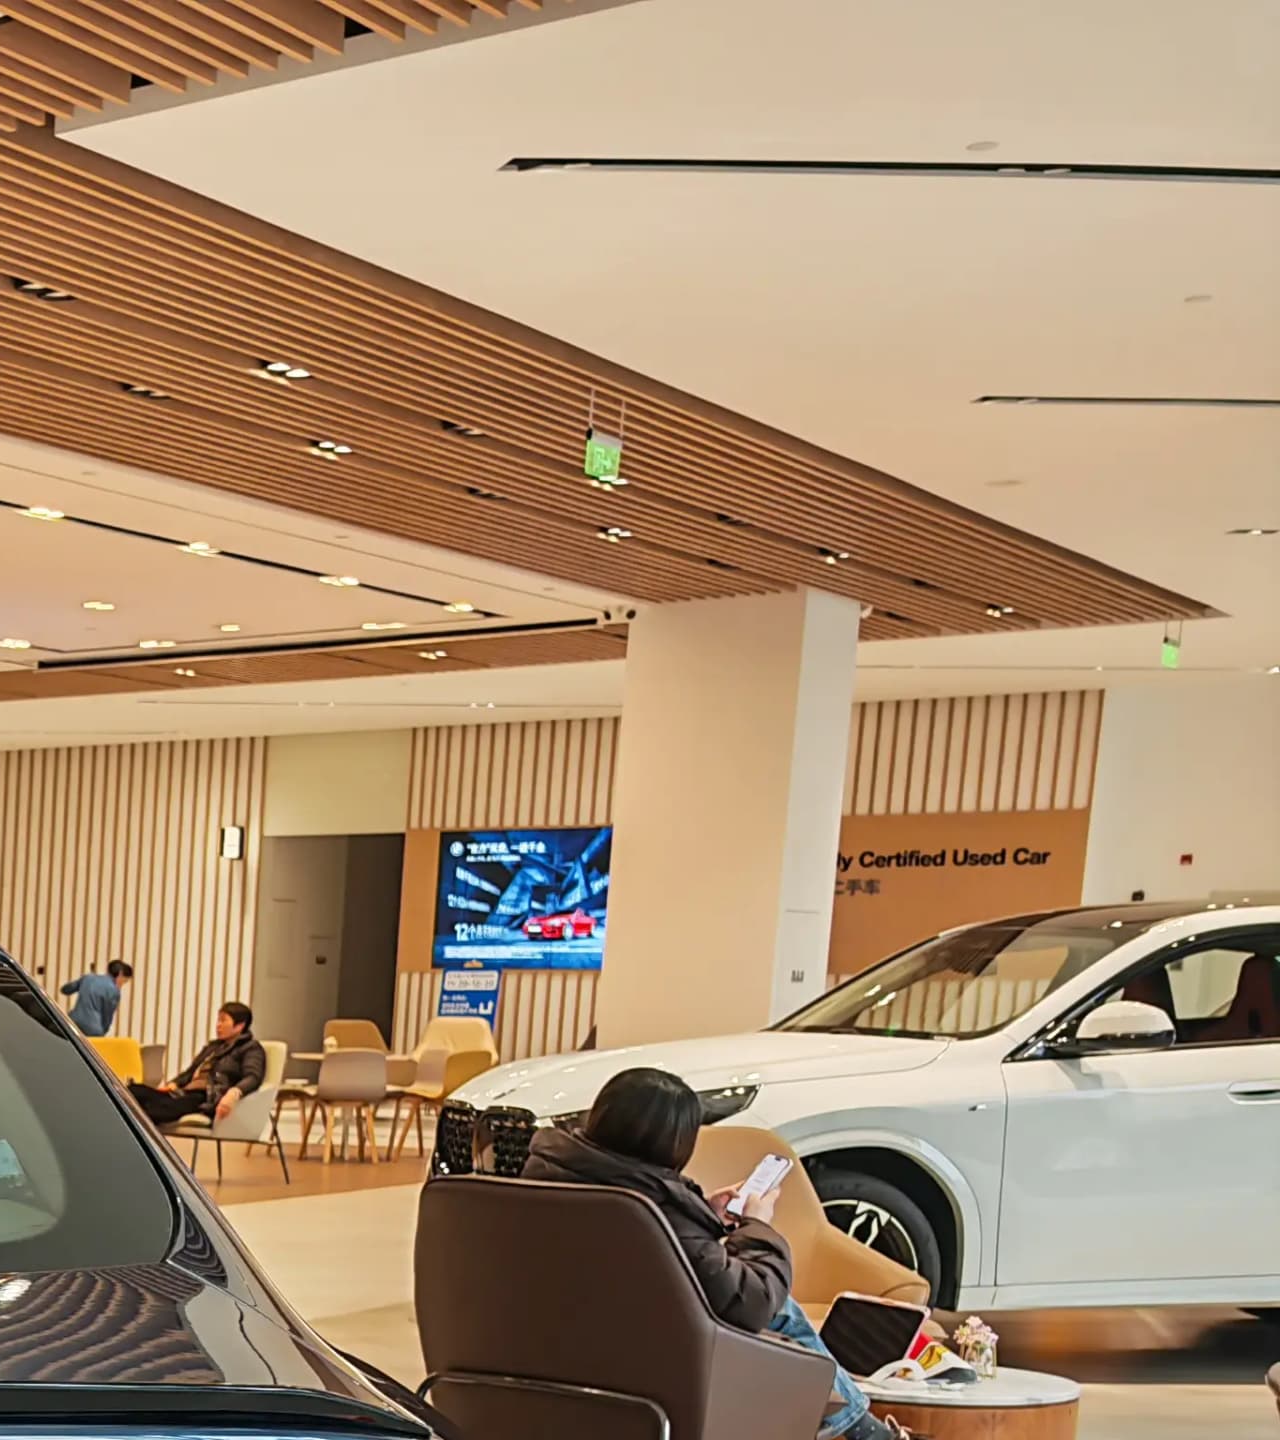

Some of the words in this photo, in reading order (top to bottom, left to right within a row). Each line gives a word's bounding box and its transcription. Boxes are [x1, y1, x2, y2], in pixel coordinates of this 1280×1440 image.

[858, 849, 946, 868] Certified
[952, 848, 1006, 866] Used
[1012, 847, 1051, 866] Car
